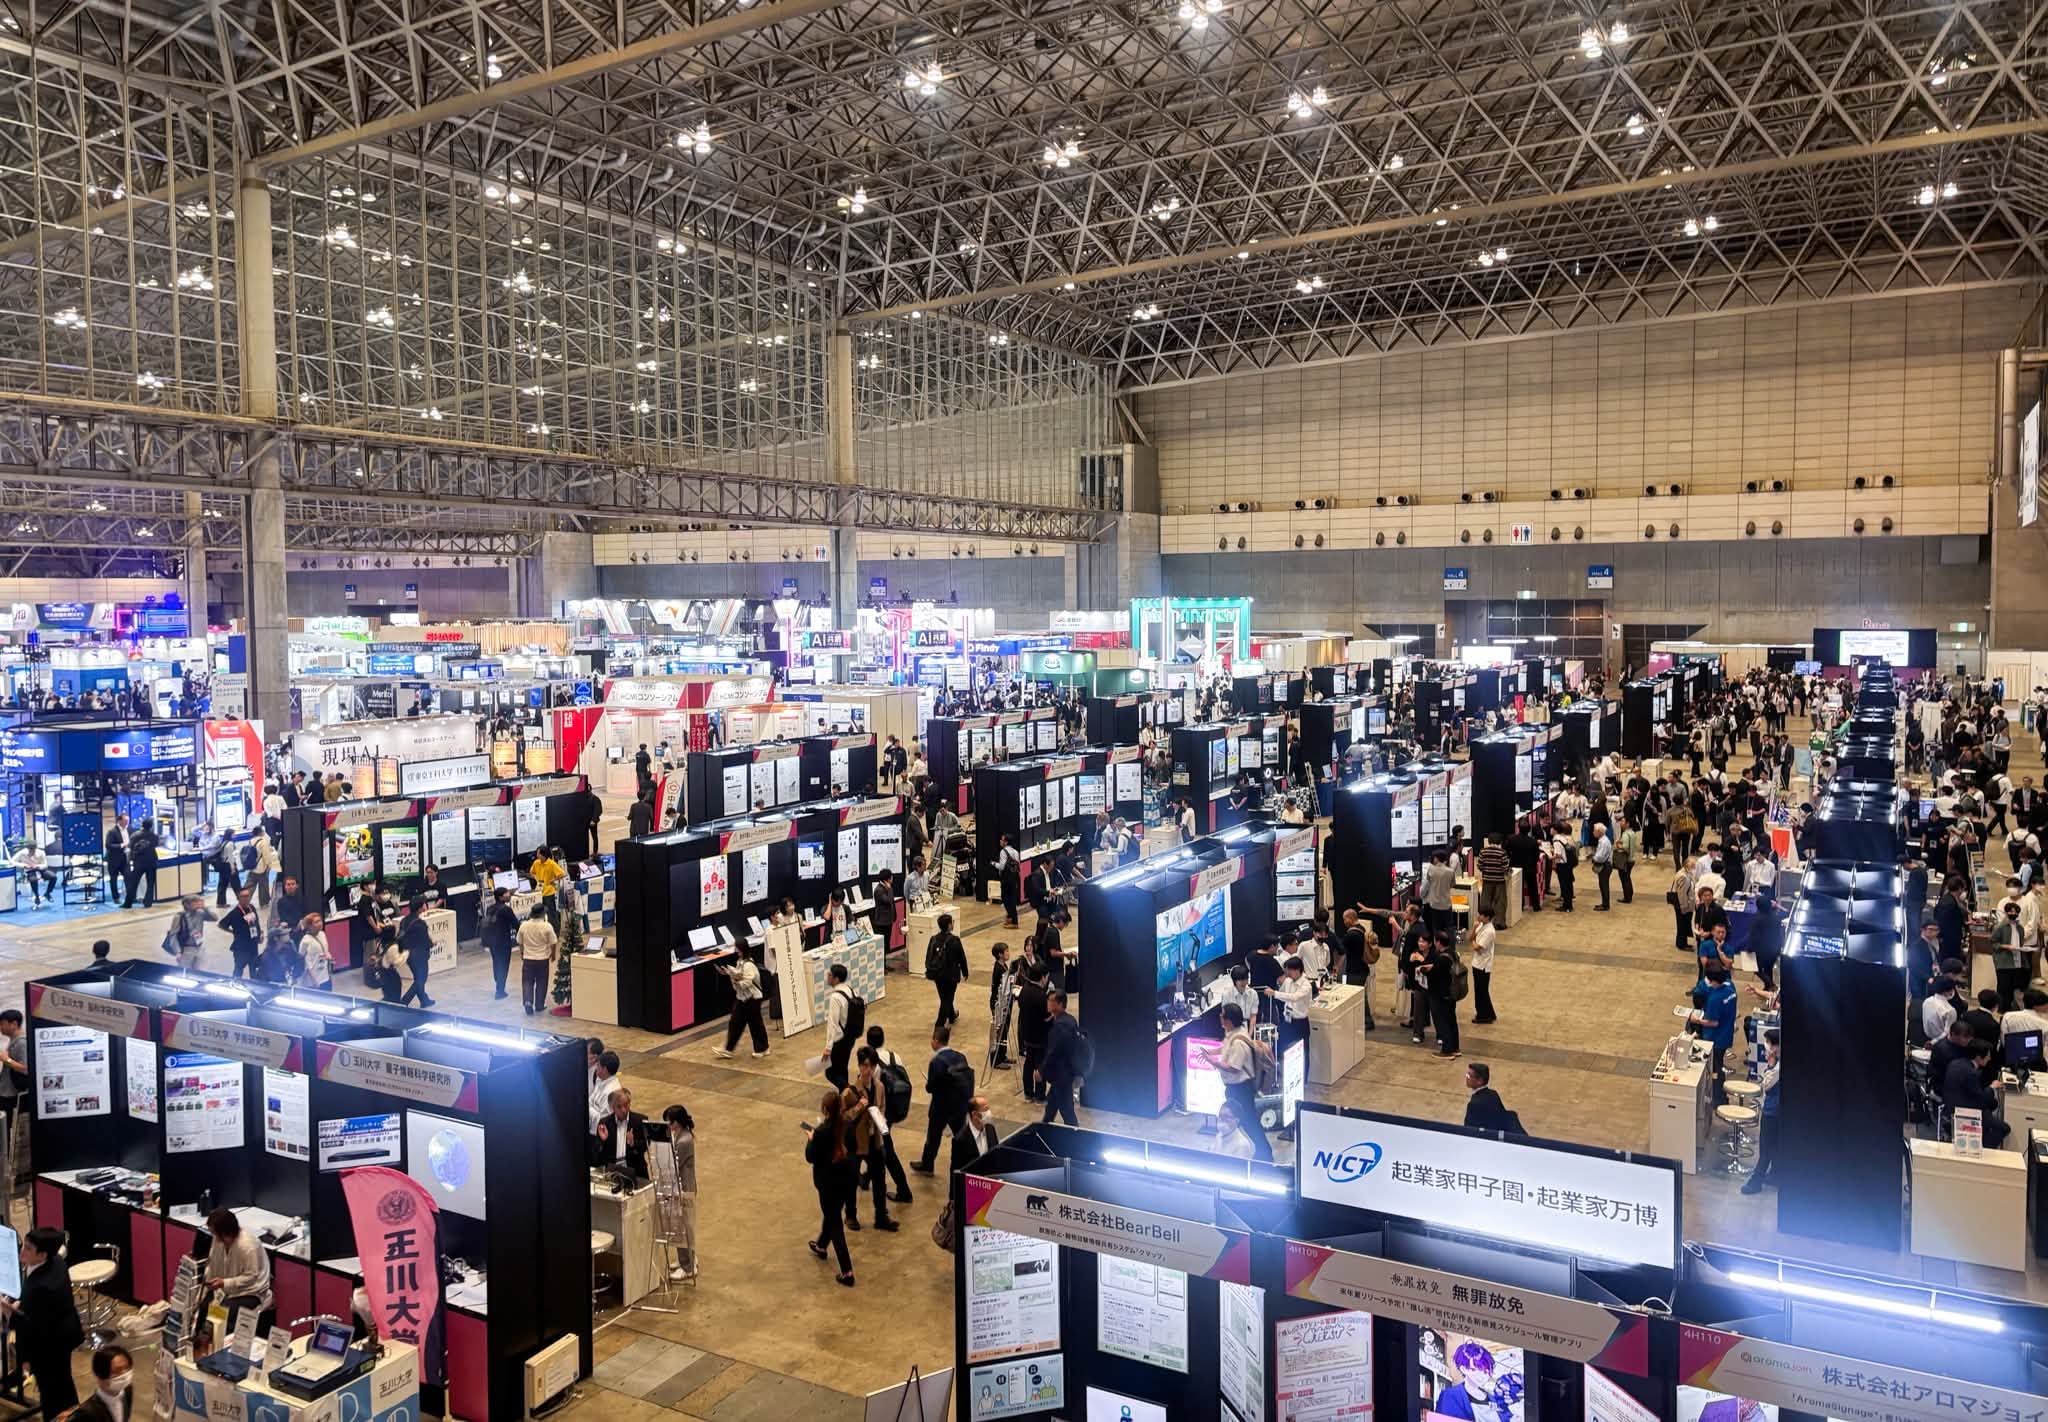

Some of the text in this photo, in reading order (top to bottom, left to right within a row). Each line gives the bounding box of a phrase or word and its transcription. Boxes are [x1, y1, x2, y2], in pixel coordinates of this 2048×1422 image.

[424, 632, 464, 641] SHARP
[353, 1055, 381, 1073] 玉川大学
[385, 1061, 451, 1087] 量子情報科学研究所
[1313, 1150, 1659, 1229] NICT 起業家甲子園・起業家万博
[1058, 1203, 1181, 1243] 株式会社BearBell
[1452, 1283, 1525, 1316] 無罪放免
[1683, 1329, 1722, 1345] 4H110
